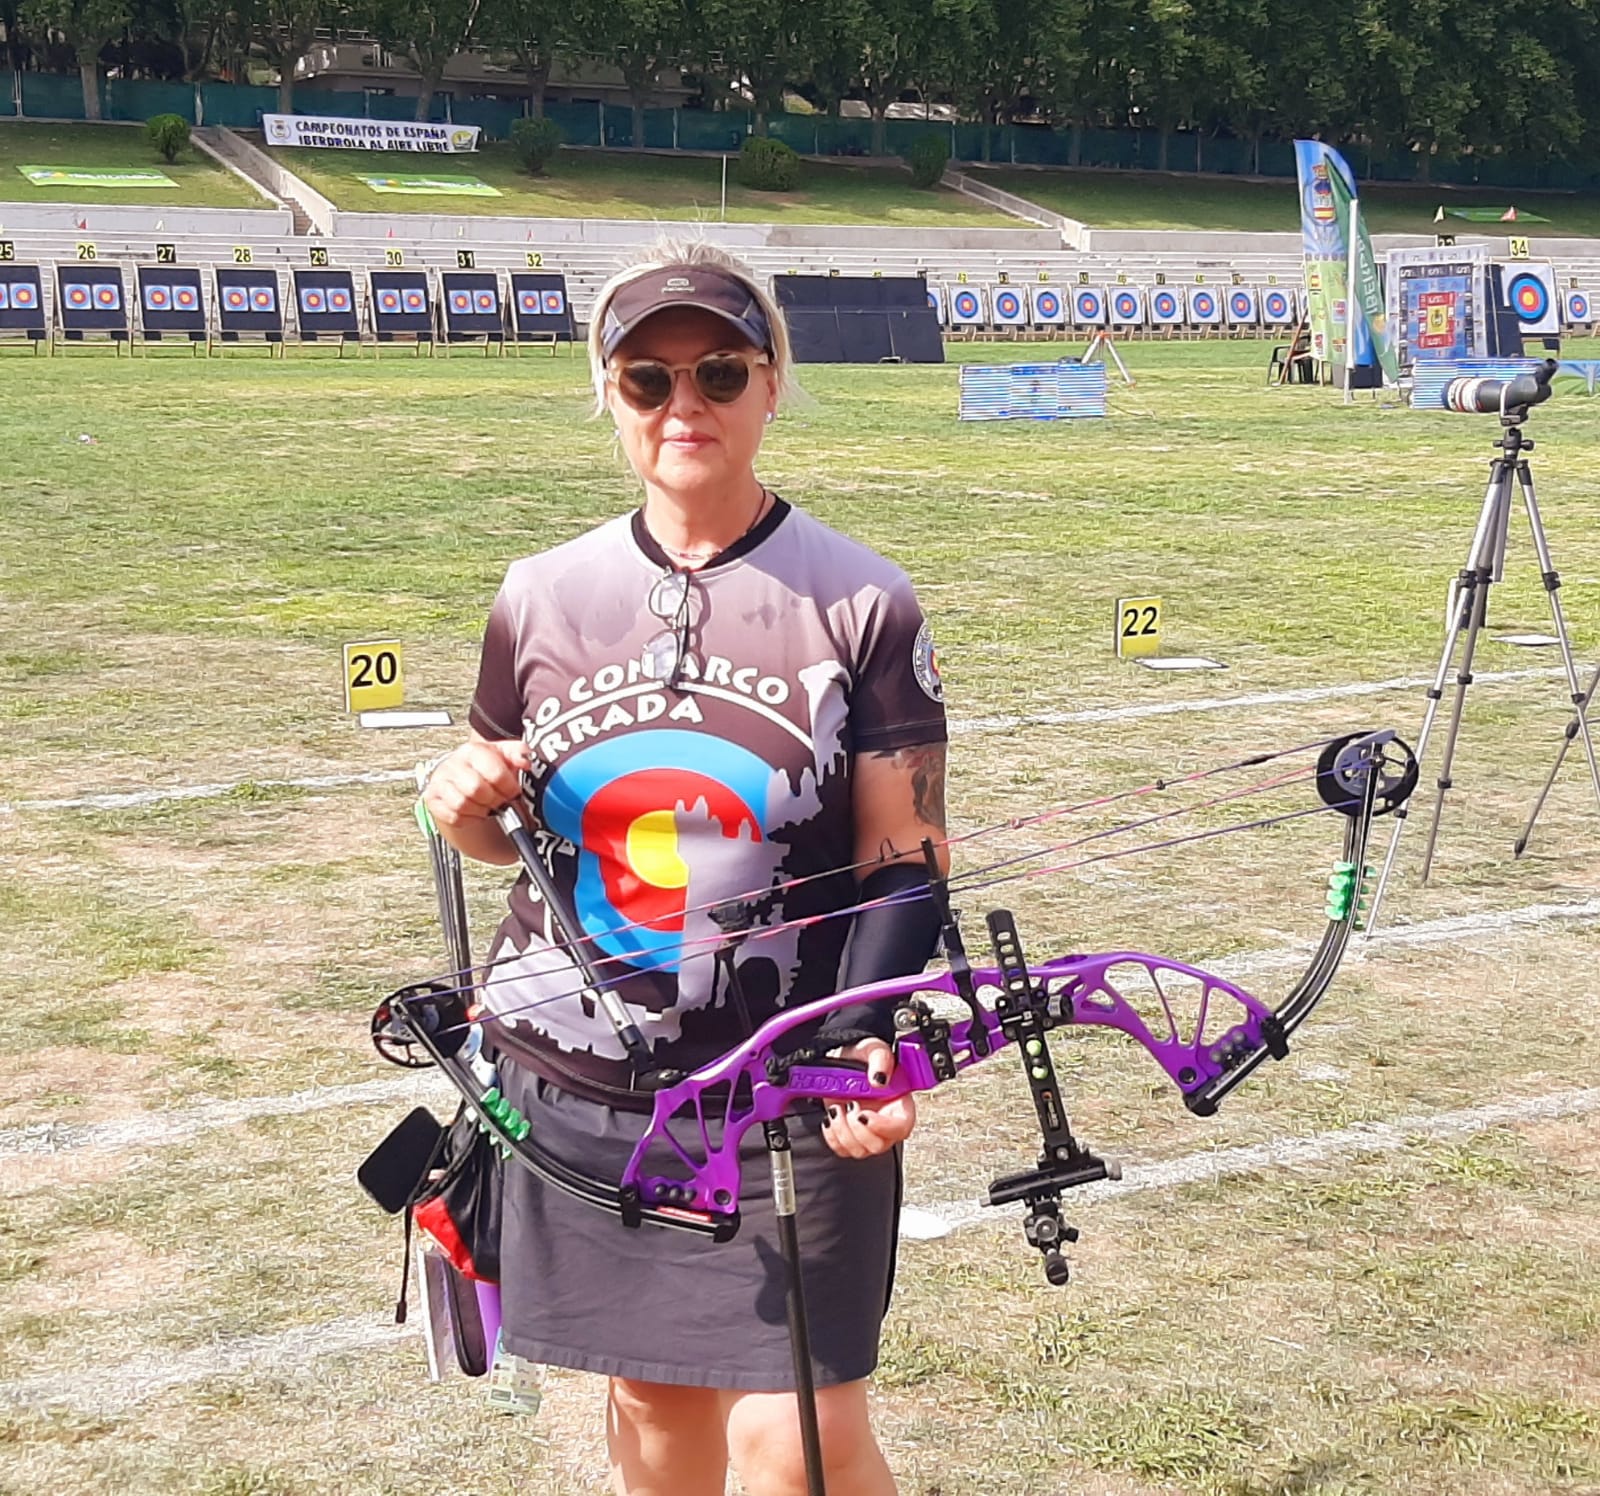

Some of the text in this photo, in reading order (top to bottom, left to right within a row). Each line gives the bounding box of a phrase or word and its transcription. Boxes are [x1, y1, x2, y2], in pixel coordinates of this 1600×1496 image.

[296, 120, 447, 139] CAMPEONATOS DE ESPAÑA
[298, 136, 365, 148] IBERDROLA
[369, 137, 383, 149] AL
[78, 245, 96, 260] 26
[157, 246, 174, 262] 27
[234, 248, 251, 263] 28
[1511, 240, 1528, 256] 34
[311, 250, 327, 265] 29
[386, 251, 403, 265] 30
[457, 252, 474, 268] 31
[527, 253, 542, 267] 32
[1122, 606, 1158, 637] 22
[350, 651, 397, 688] 20
[569, 653, 655, 703] CON
[680, 652, 789, 705] ARCO
